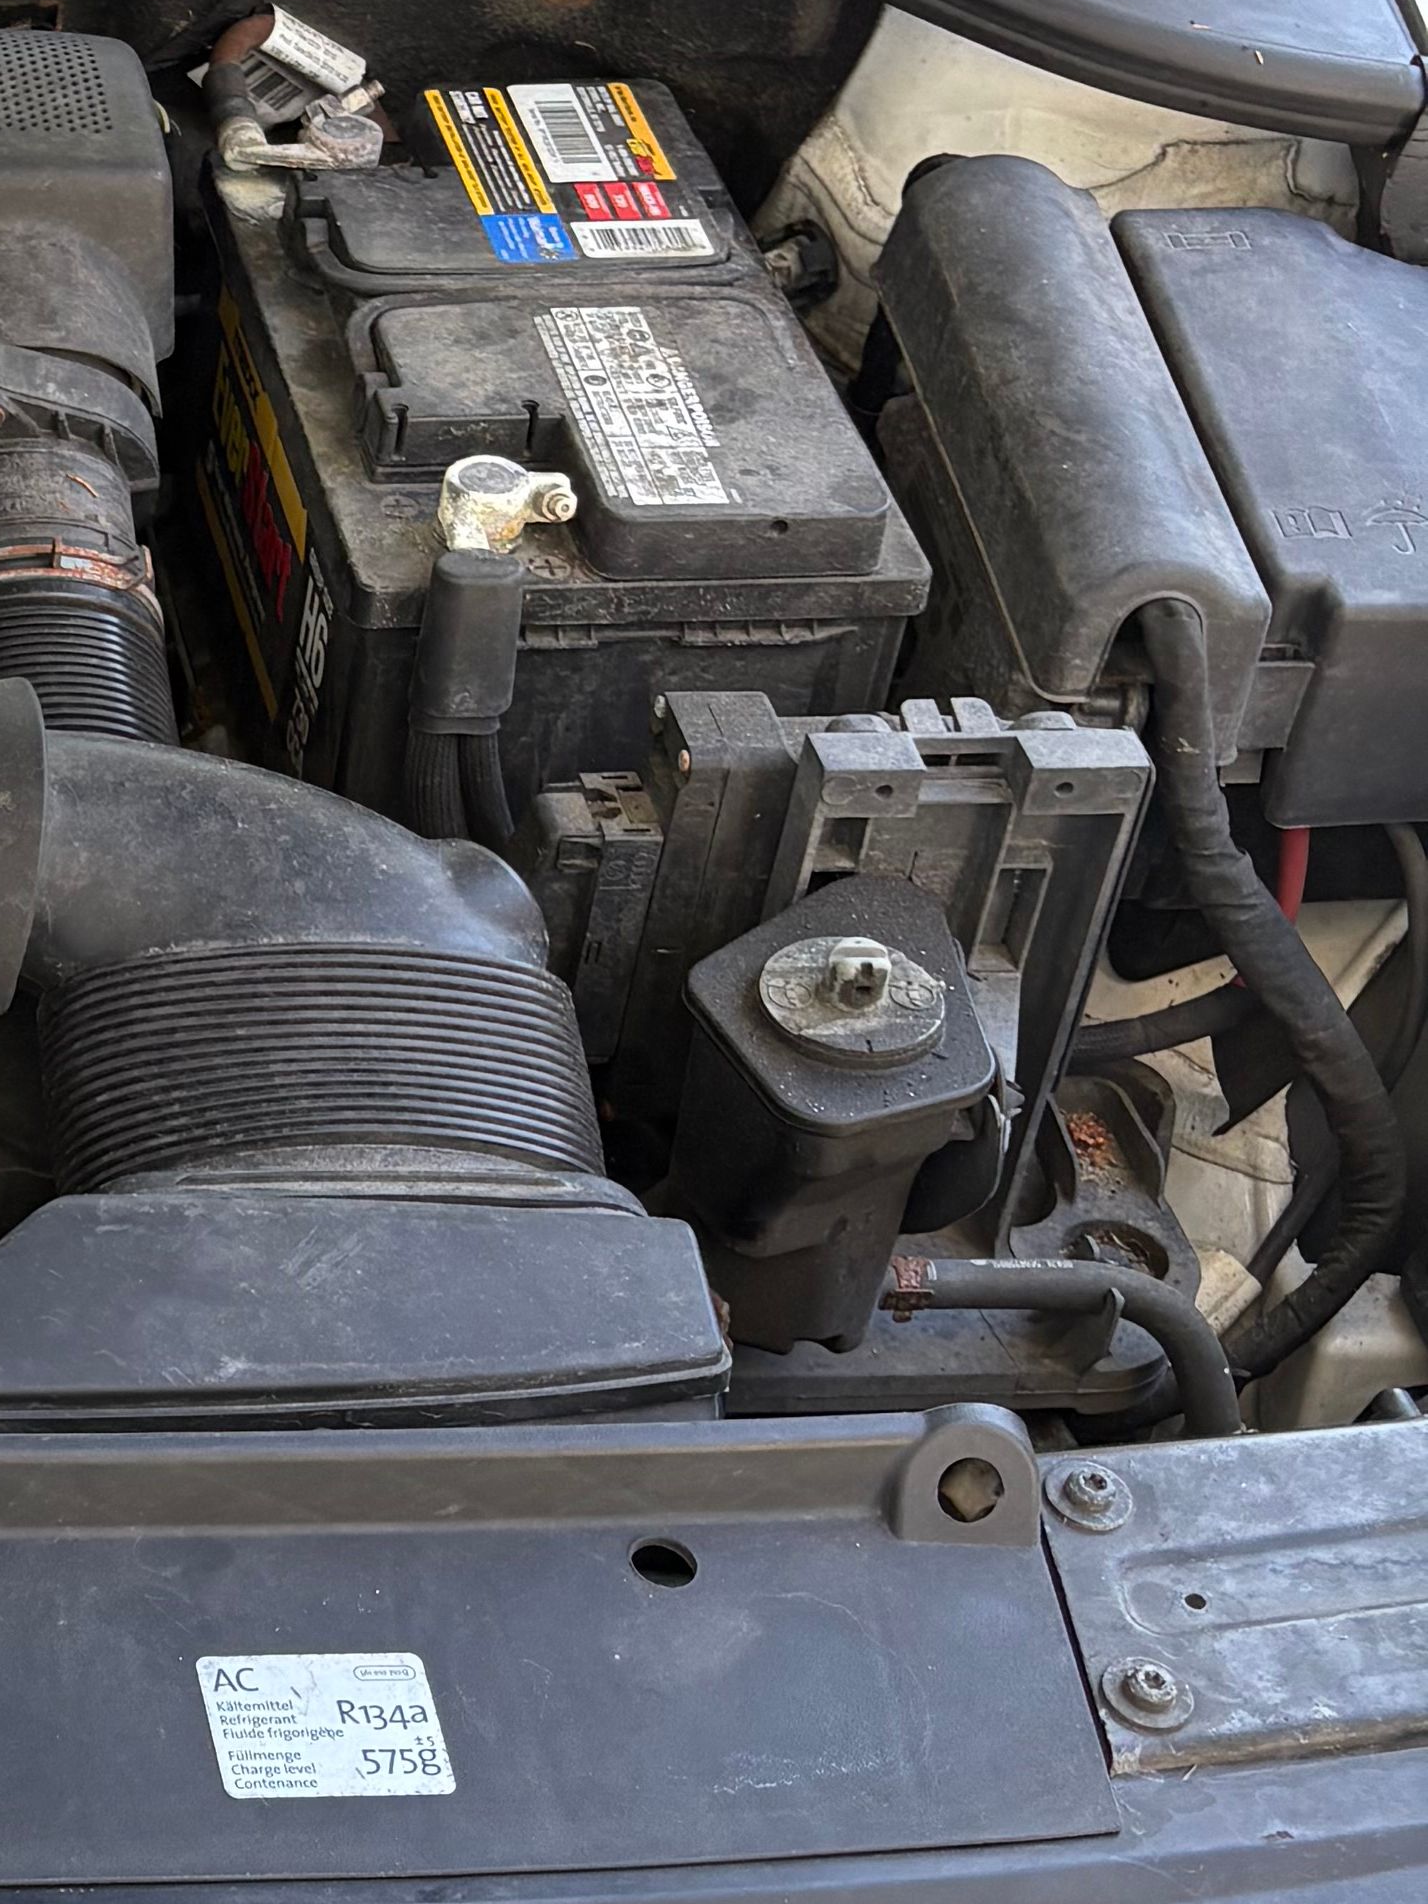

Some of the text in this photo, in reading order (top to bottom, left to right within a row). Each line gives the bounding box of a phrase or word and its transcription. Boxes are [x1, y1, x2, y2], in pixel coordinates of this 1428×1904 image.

[299, 574, 329, 689] H6
[213, 1667, 259, 1692] AC
[216, 1699, 429, 1730] Kältemittel R134a
[220, 1714, 298, 1728] Refrigerant
[223, 1727, 345, 1742] Fluide frigorigène
[228, 1748, 442, 1776] Füllmenge 575g
[231, 1763, 316, 1777] Charge level
[234, 1777, 318, 1789] Contenance
